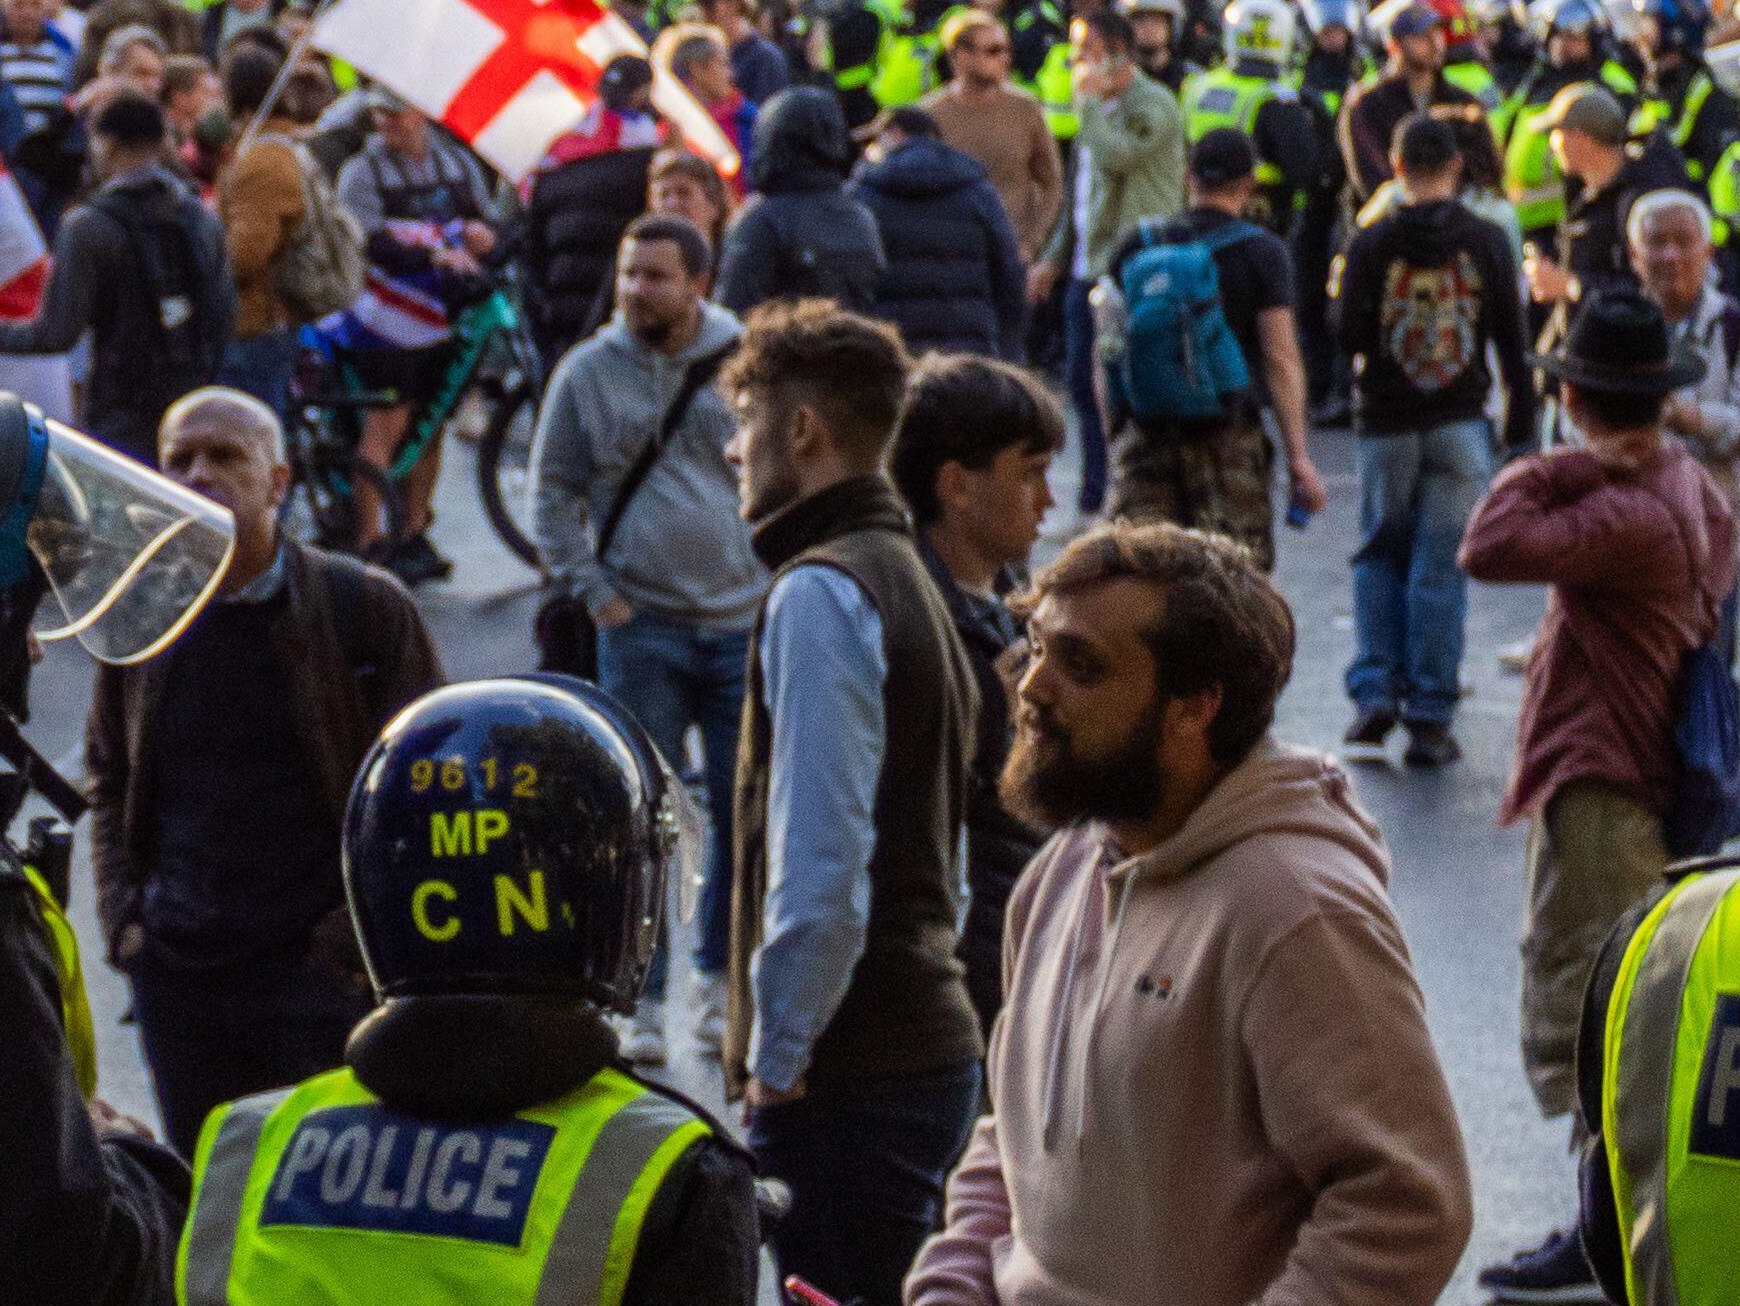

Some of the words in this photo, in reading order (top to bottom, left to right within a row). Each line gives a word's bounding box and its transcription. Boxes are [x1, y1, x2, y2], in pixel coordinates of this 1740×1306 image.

[410, 757, 538, 798] 9612
[429, 808, 511, 859] MP
[272, 1123, 535, 1221] POLICE
